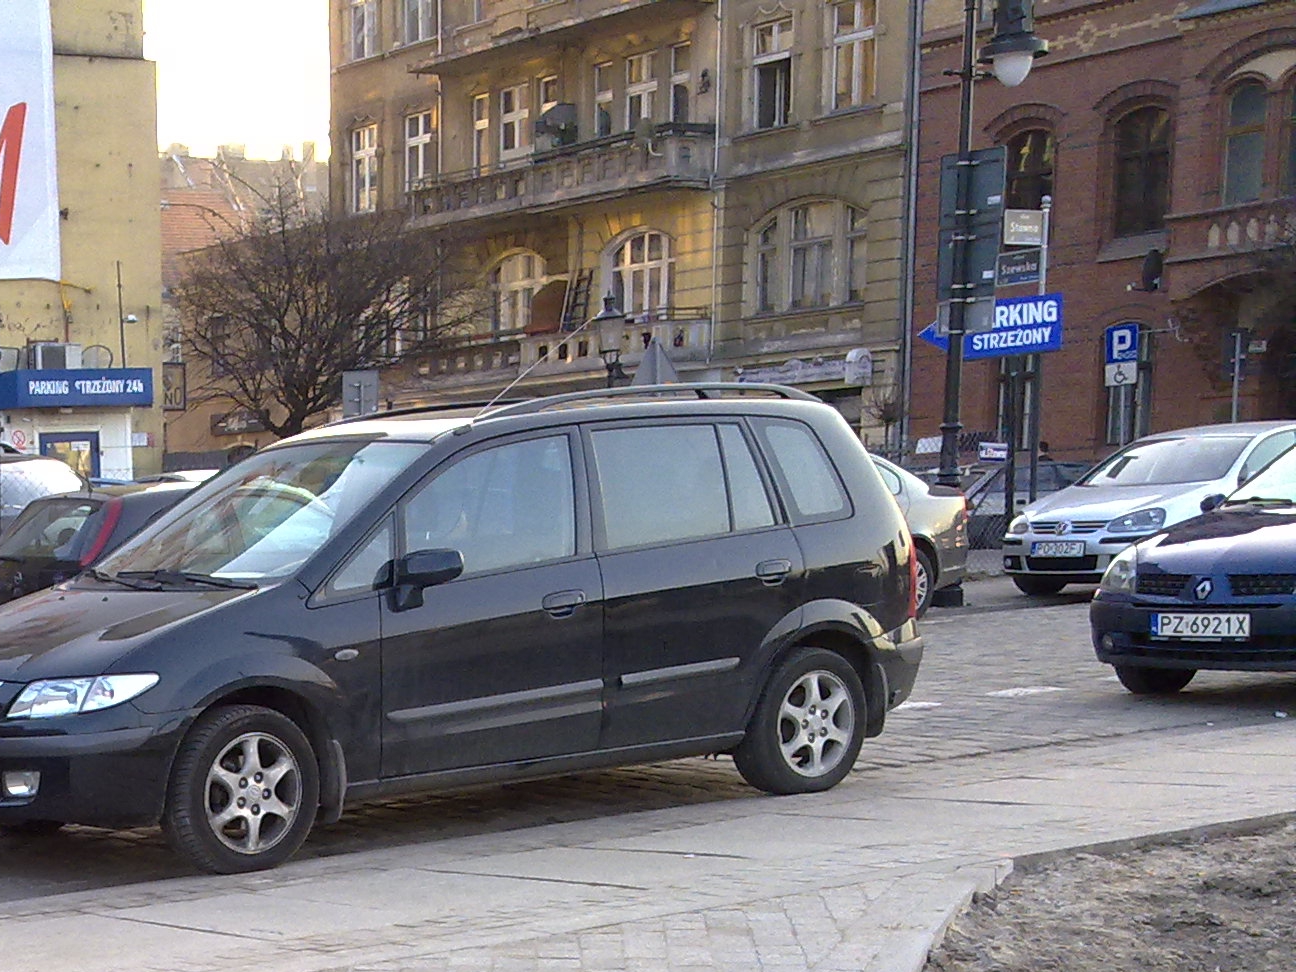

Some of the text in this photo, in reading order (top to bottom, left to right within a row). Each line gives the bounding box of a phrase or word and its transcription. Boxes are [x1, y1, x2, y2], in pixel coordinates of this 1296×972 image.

[992, 300, 1058, 328] RKING
[972, 326, 1052, 350] STRZEŻONY
[28, 380, 69, 394] PARKING
[126, 379, 144, 393] 24h
[1160, 615, 1247, 635] PZ 6921X
